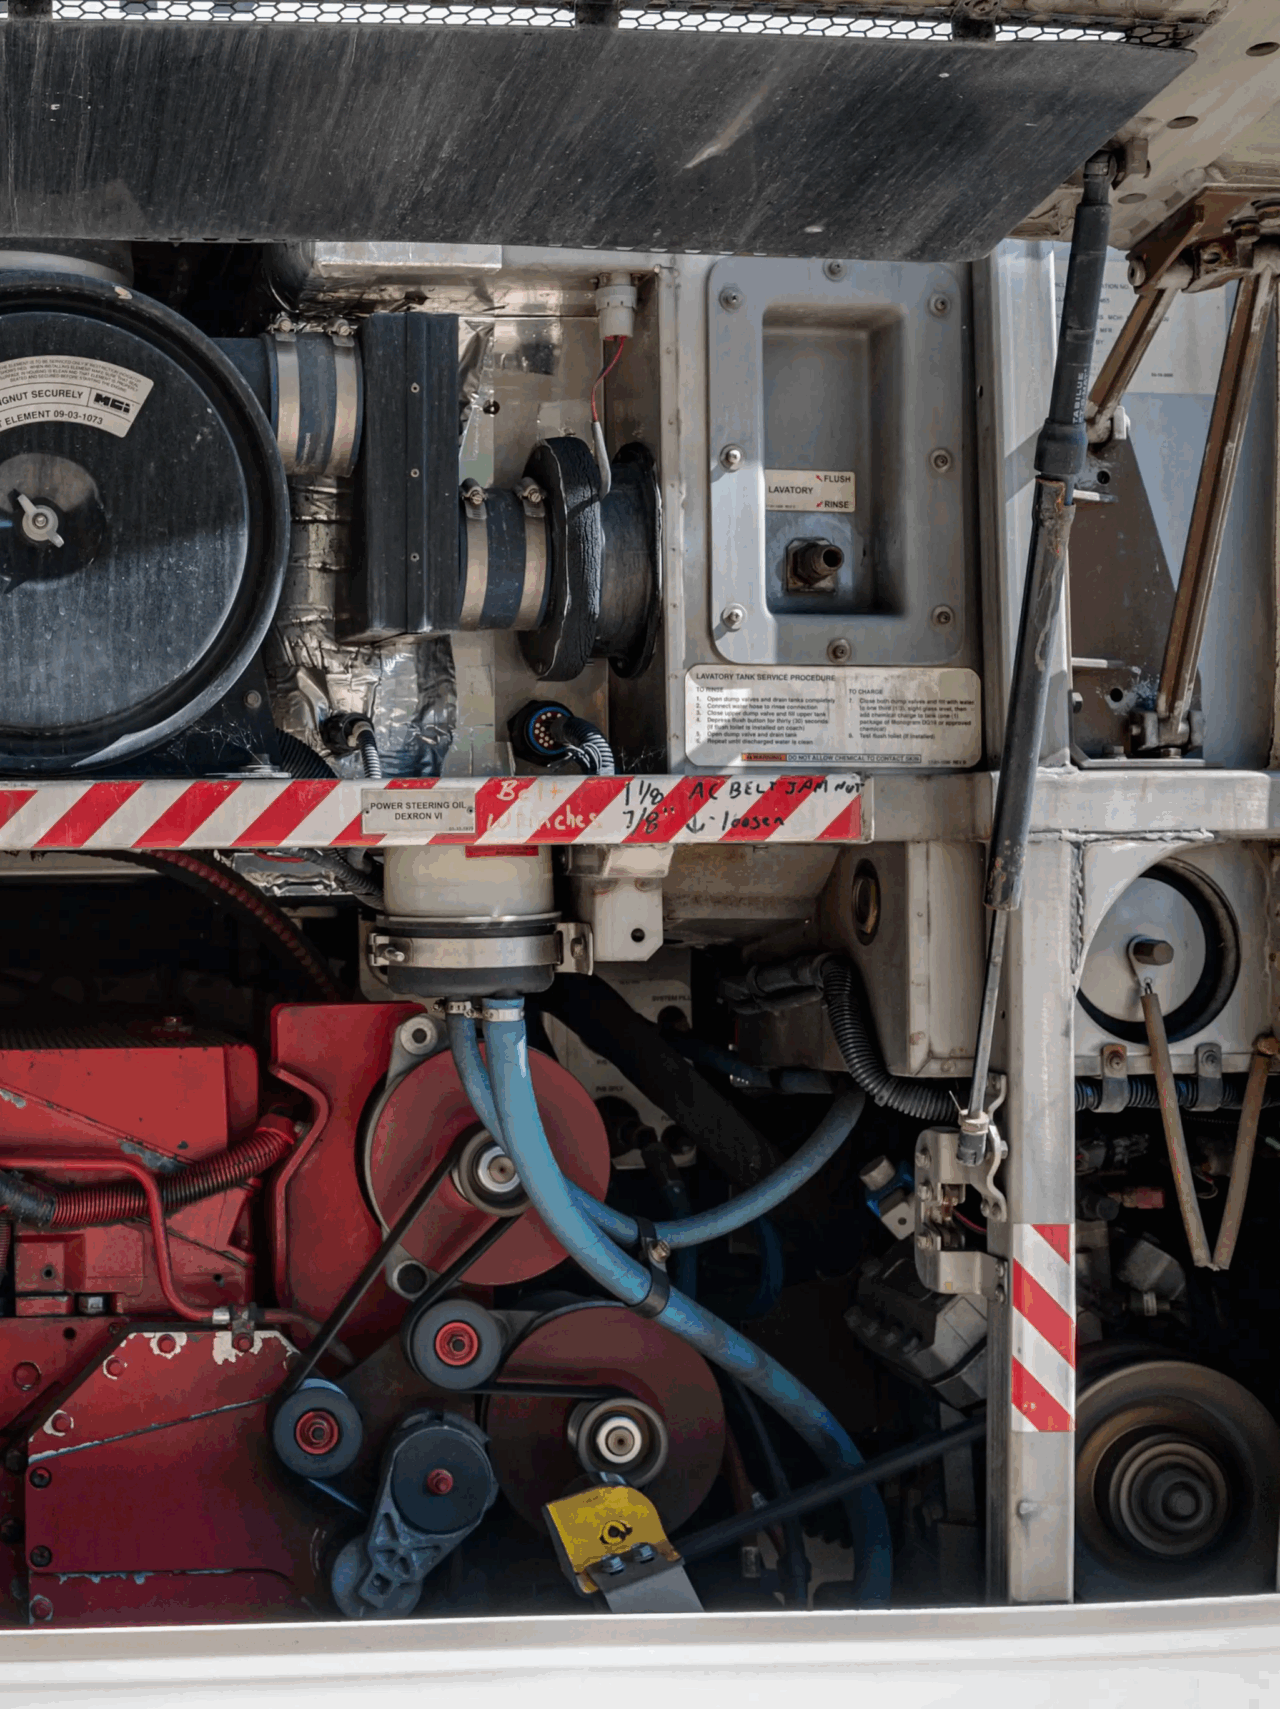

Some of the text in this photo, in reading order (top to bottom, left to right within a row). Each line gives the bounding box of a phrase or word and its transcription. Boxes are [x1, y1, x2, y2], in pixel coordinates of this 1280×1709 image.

[31, 390, 83, 399] SECURELY
[6, 410, 51, 425] ELEMENT
[54, 411, 103, 425] 09-03-1073
[730, 780, 777, 798] BELT
[785, 779, 829, 795] JAM
[406, 802, 450, 810] STEERING
[394, 812, 432, 820] DEXRON
